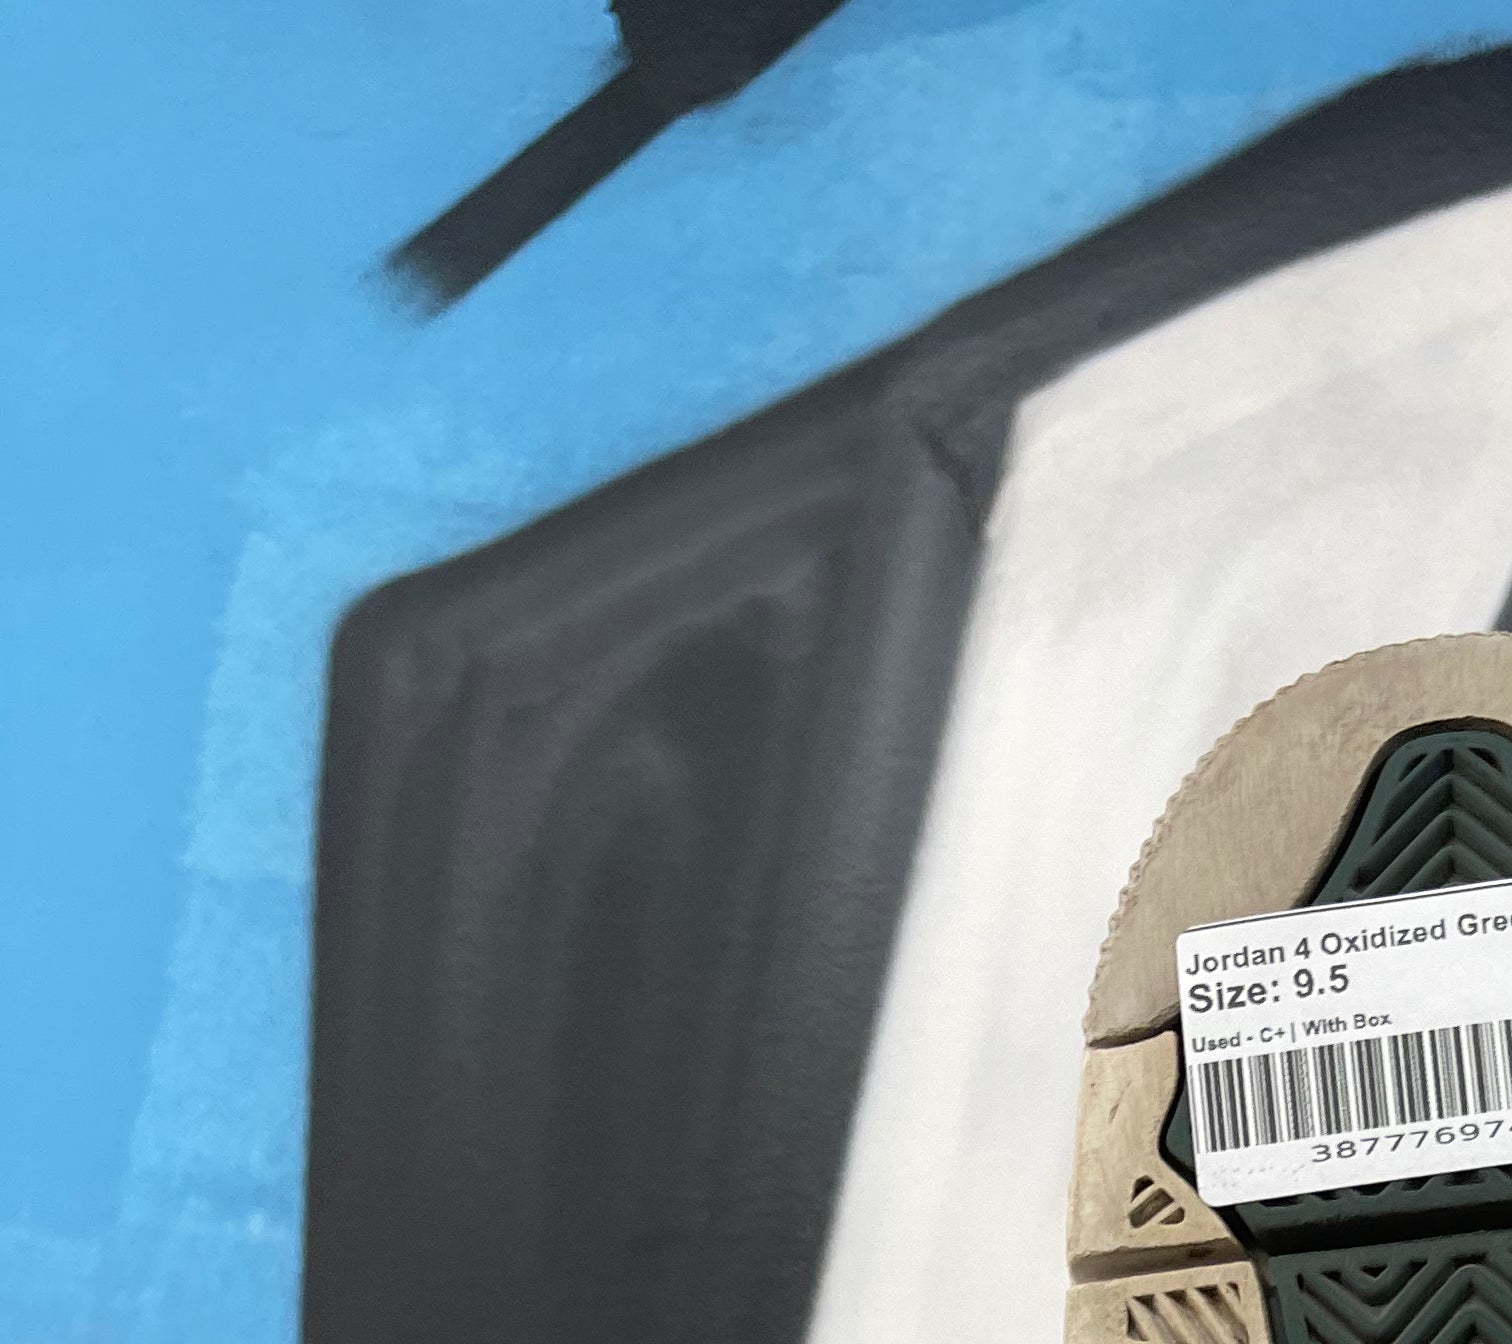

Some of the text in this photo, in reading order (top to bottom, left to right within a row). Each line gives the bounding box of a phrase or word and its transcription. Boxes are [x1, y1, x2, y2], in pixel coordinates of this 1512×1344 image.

[1186, 945, 1285, 976] Jordan
[1295, 937, 1312, 960] 4
[1321, 919, 1447, 956] Oxidized
[1188, 964, 1349, 1013] Size: 9.5
[1192, 1032, 1241, 1053] Used
[1302, 1016, 1347, 1036] With
[1353, 1013, 1393, 1030] Box
